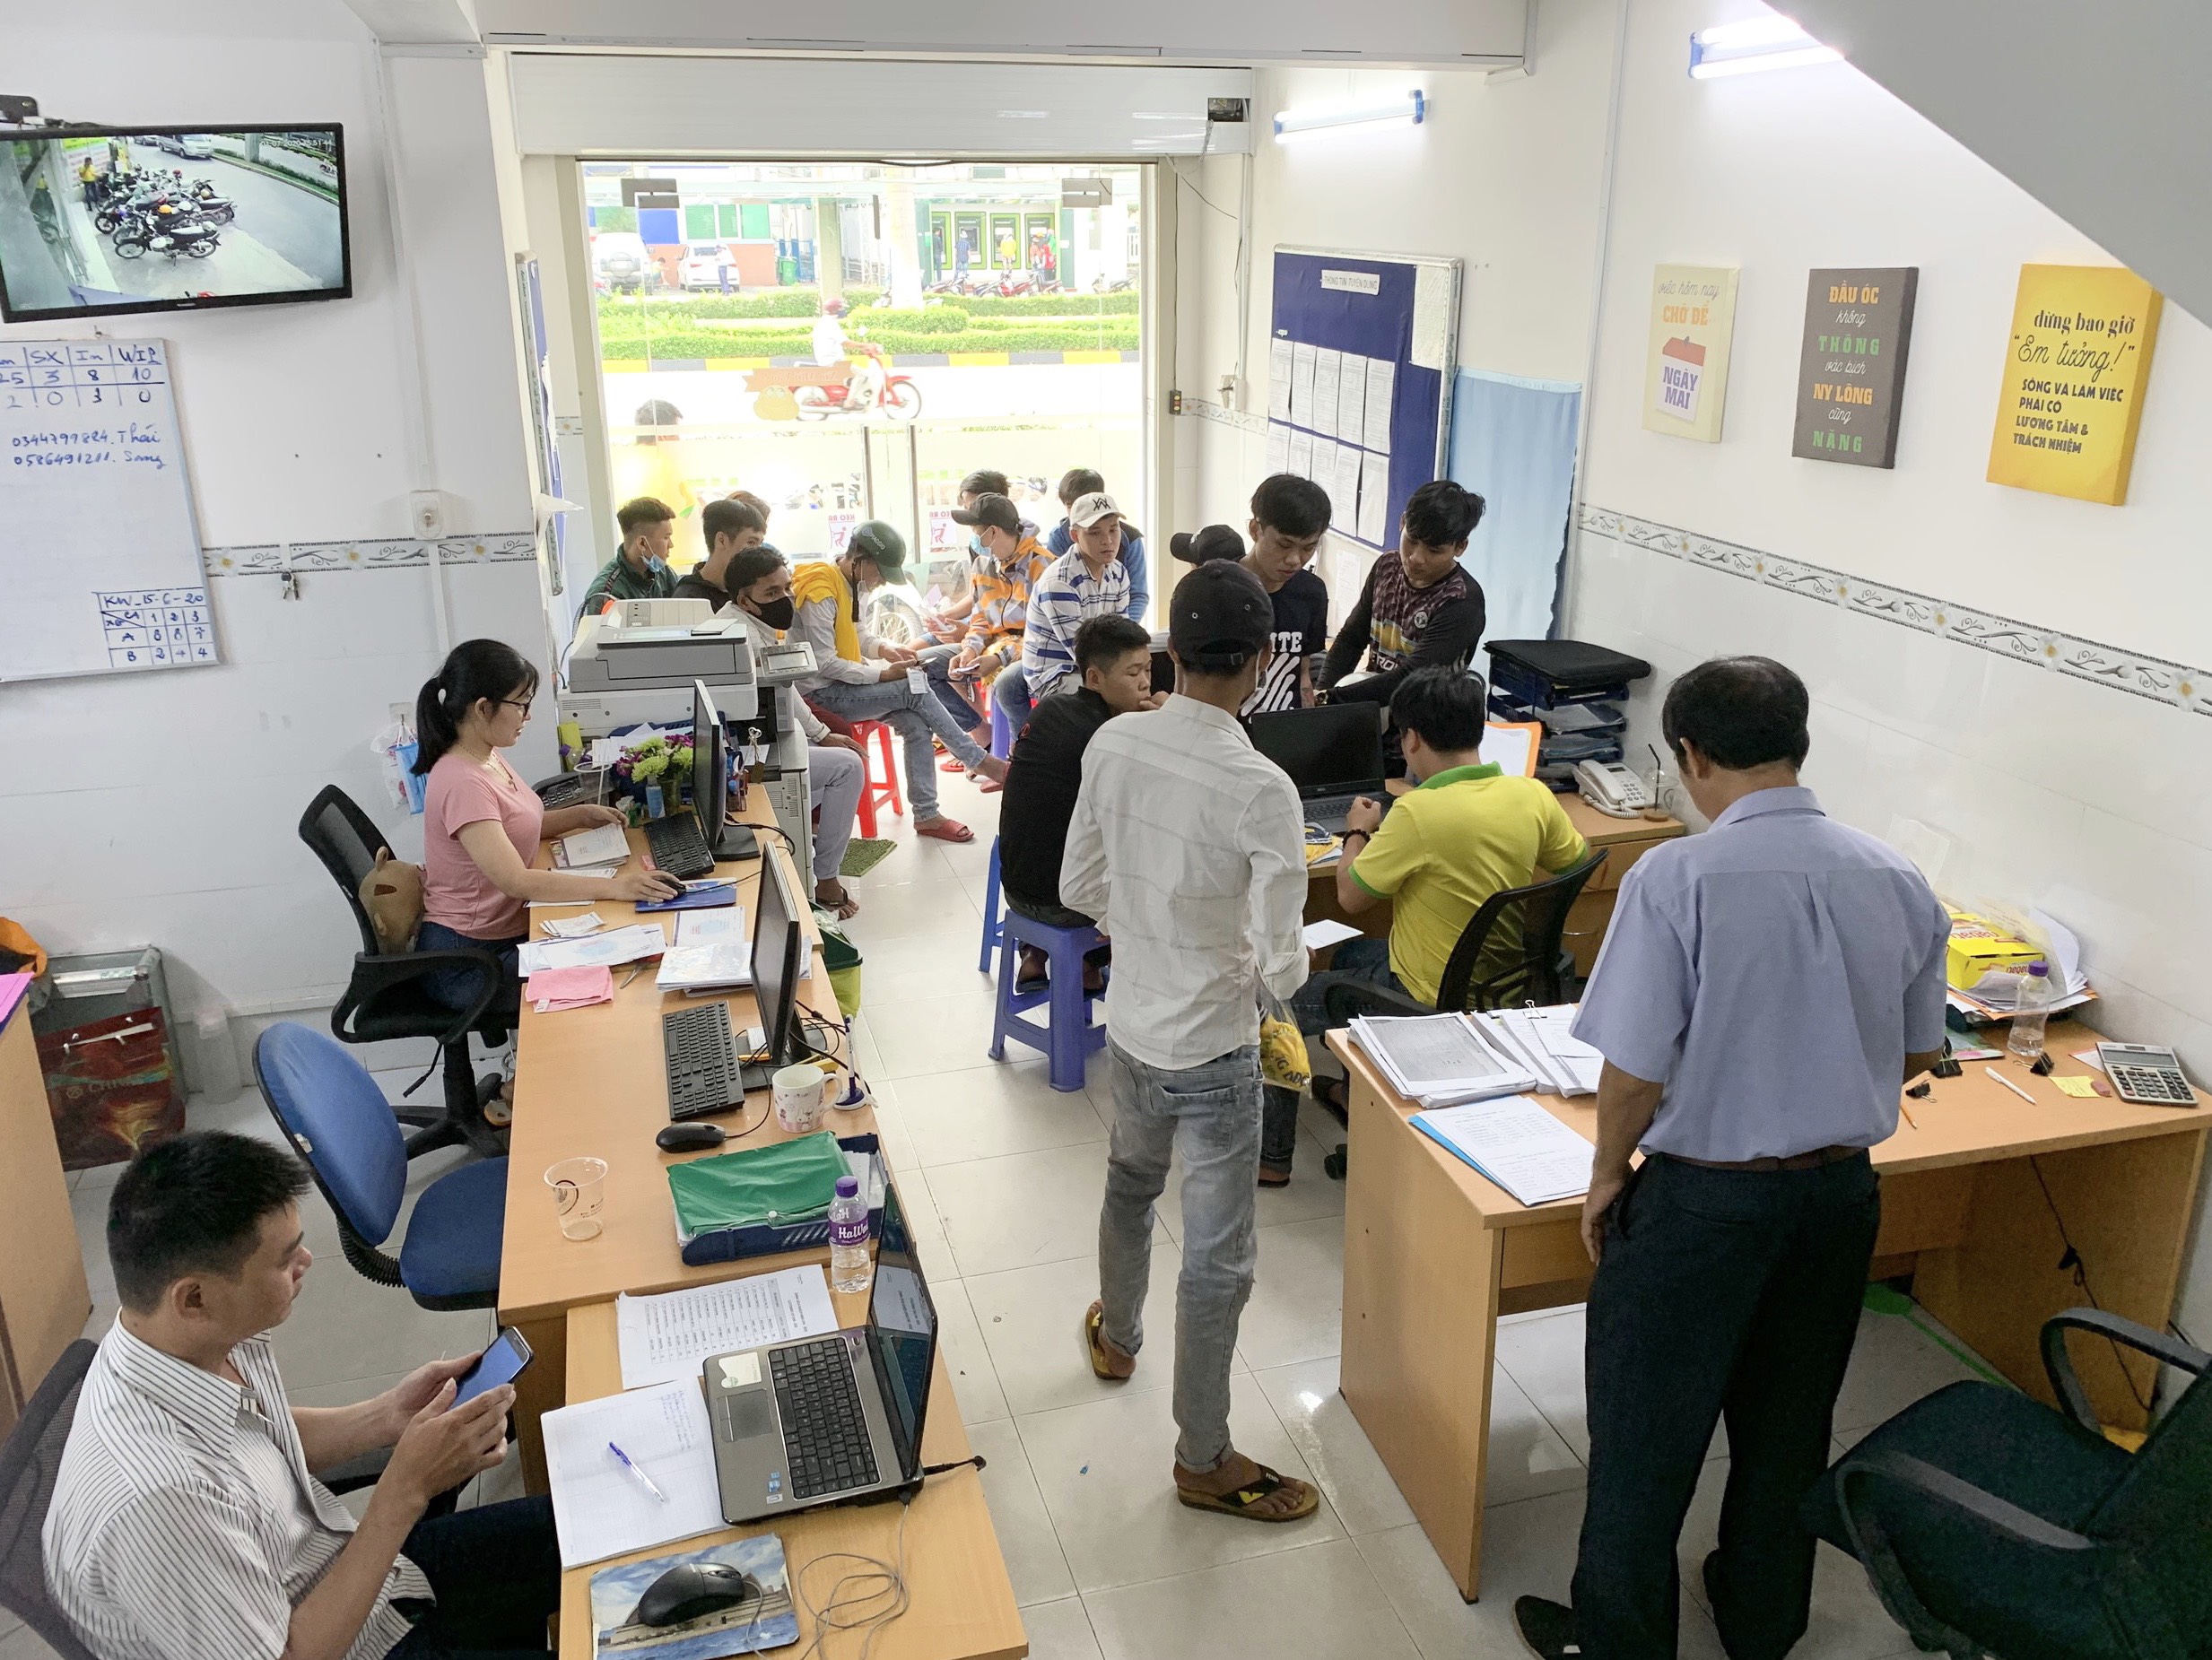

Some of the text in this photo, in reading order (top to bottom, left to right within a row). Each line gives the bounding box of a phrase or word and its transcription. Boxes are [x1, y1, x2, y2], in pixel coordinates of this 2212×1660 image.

[1701, 284, 1720, 300] nay
[1860, 283, 1879, 304] ÓC
[1836, 309, 1866, 327] không
[2076, 313, 2104, 332] bao
[2108, 315, 2136, 339] giờ
[1818, 334, 1880, 355] THÔNG
[87, 369, 100, 381] 8
[132, 367, 152, 382] 10
[1663, 366, 1698, 391] NGÀY
[1844, 360, 1866, 377] bịch
[47, 391, 64, 405] 0
[138, 389, 152, 403] 0
[1665, 386, 1691, 409] MAI
[1814, 383, 1873, 405] NY LÔNG
[1828, 407, 1851, 424] cũng
[2016, 415, 2088, 436] LƯƠNG TÂM &
[1813, 430, 1862, 453] NẶNG
[2013, 432, 2082, 455] TRÁCH NHIỆM
